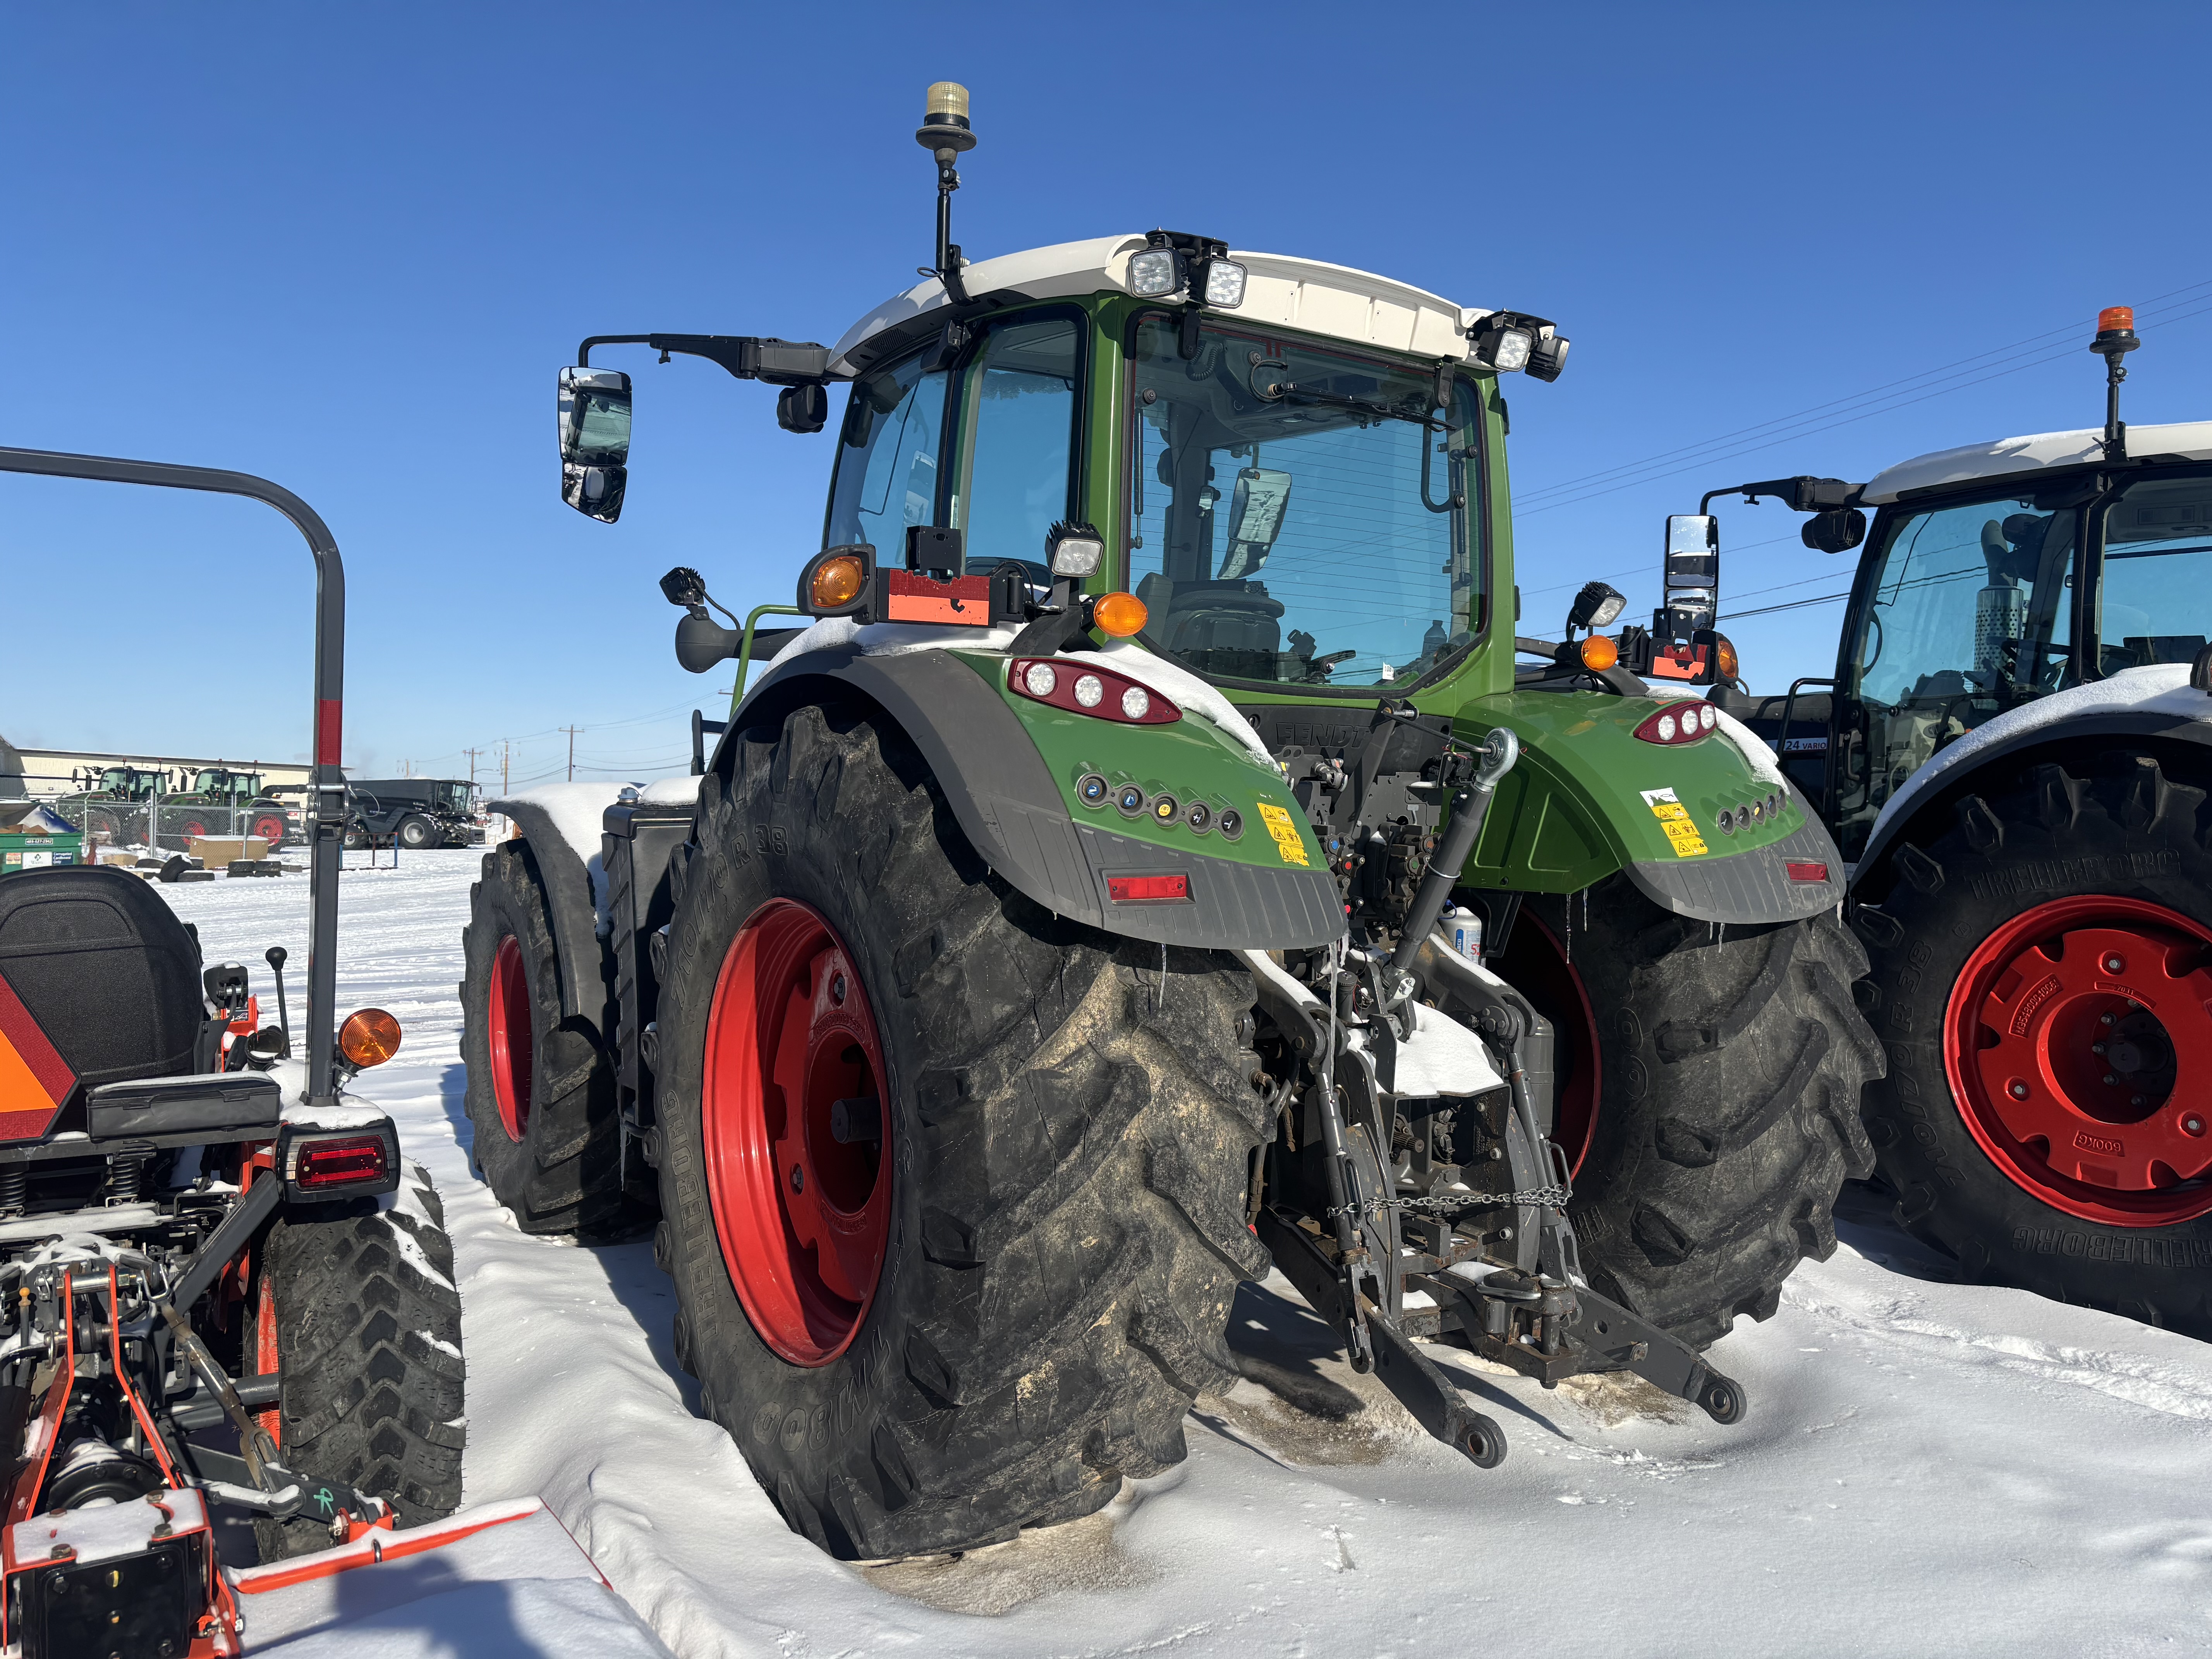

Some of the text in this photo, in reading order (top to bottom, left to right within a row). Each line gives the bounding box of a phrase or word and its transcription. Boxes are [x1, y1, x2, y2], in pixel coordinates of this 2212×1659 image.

[1276, 722, 1370, 748] FENDT
[670, 824, 790, 1011] 710/70 R 38
[1898, 940, 1933, 994] 38
[2078, 1134, 2121, 1152] 600KG
[661, 1090, 719, 1353] TRELLEBORG
